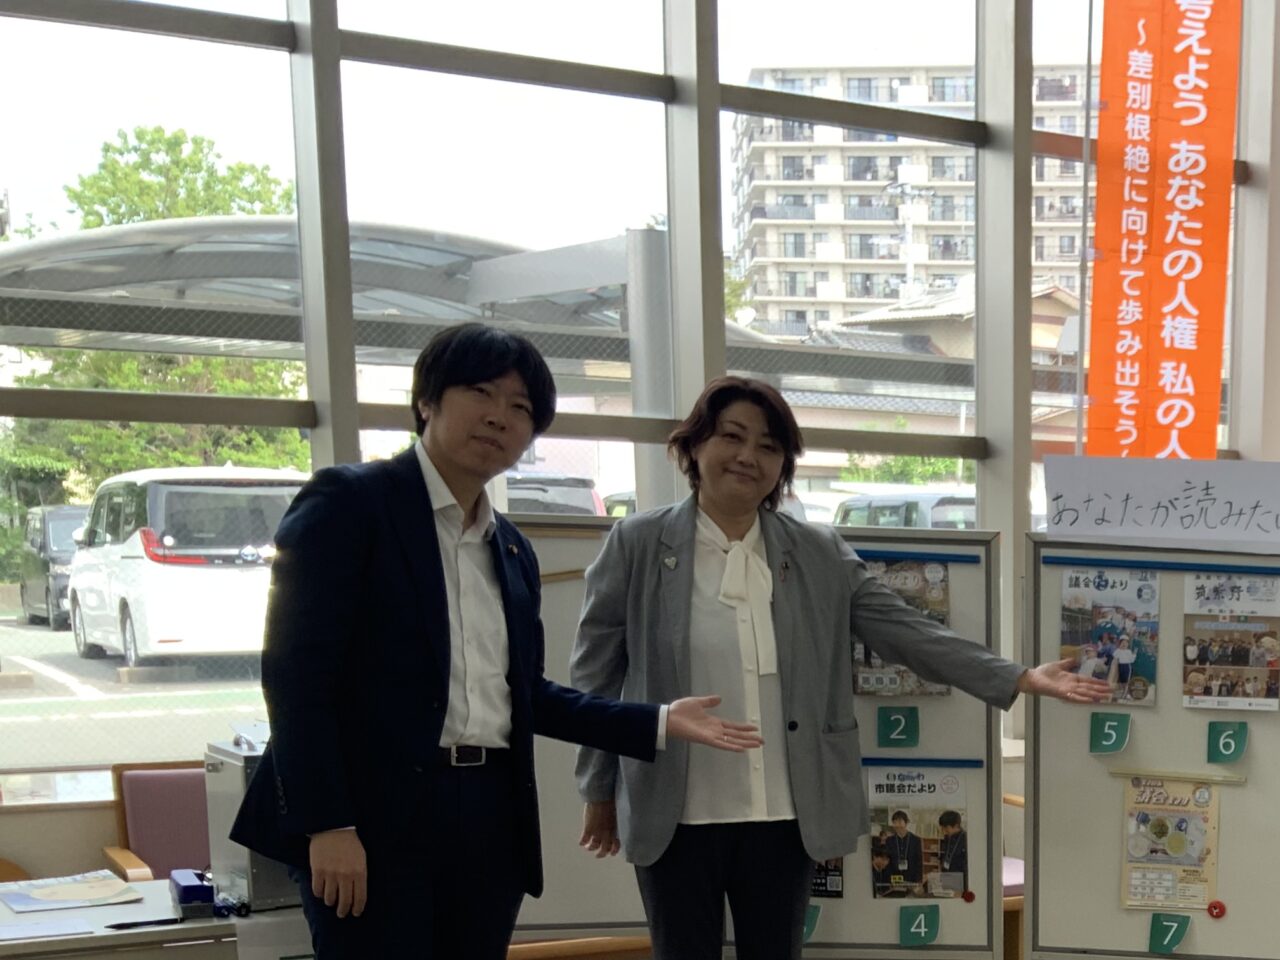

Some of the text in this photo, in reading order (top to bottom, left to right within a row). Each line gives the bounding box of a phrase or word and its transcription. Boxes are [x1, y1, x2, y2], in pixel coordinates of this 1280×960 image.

[1162, 140, 1207, 352] あなたの人権
[1155, 360, 1197, 459] 私の人
[889, 715, 907, 739] 2
[1102, 721, 1118, 746] 5
[1218, 730, 1236, 755] 6
[875, 783, 936, 794] 市議会だより
[910, 913, 928, 937] 4
[1162, 921, 1178, 945] 7
